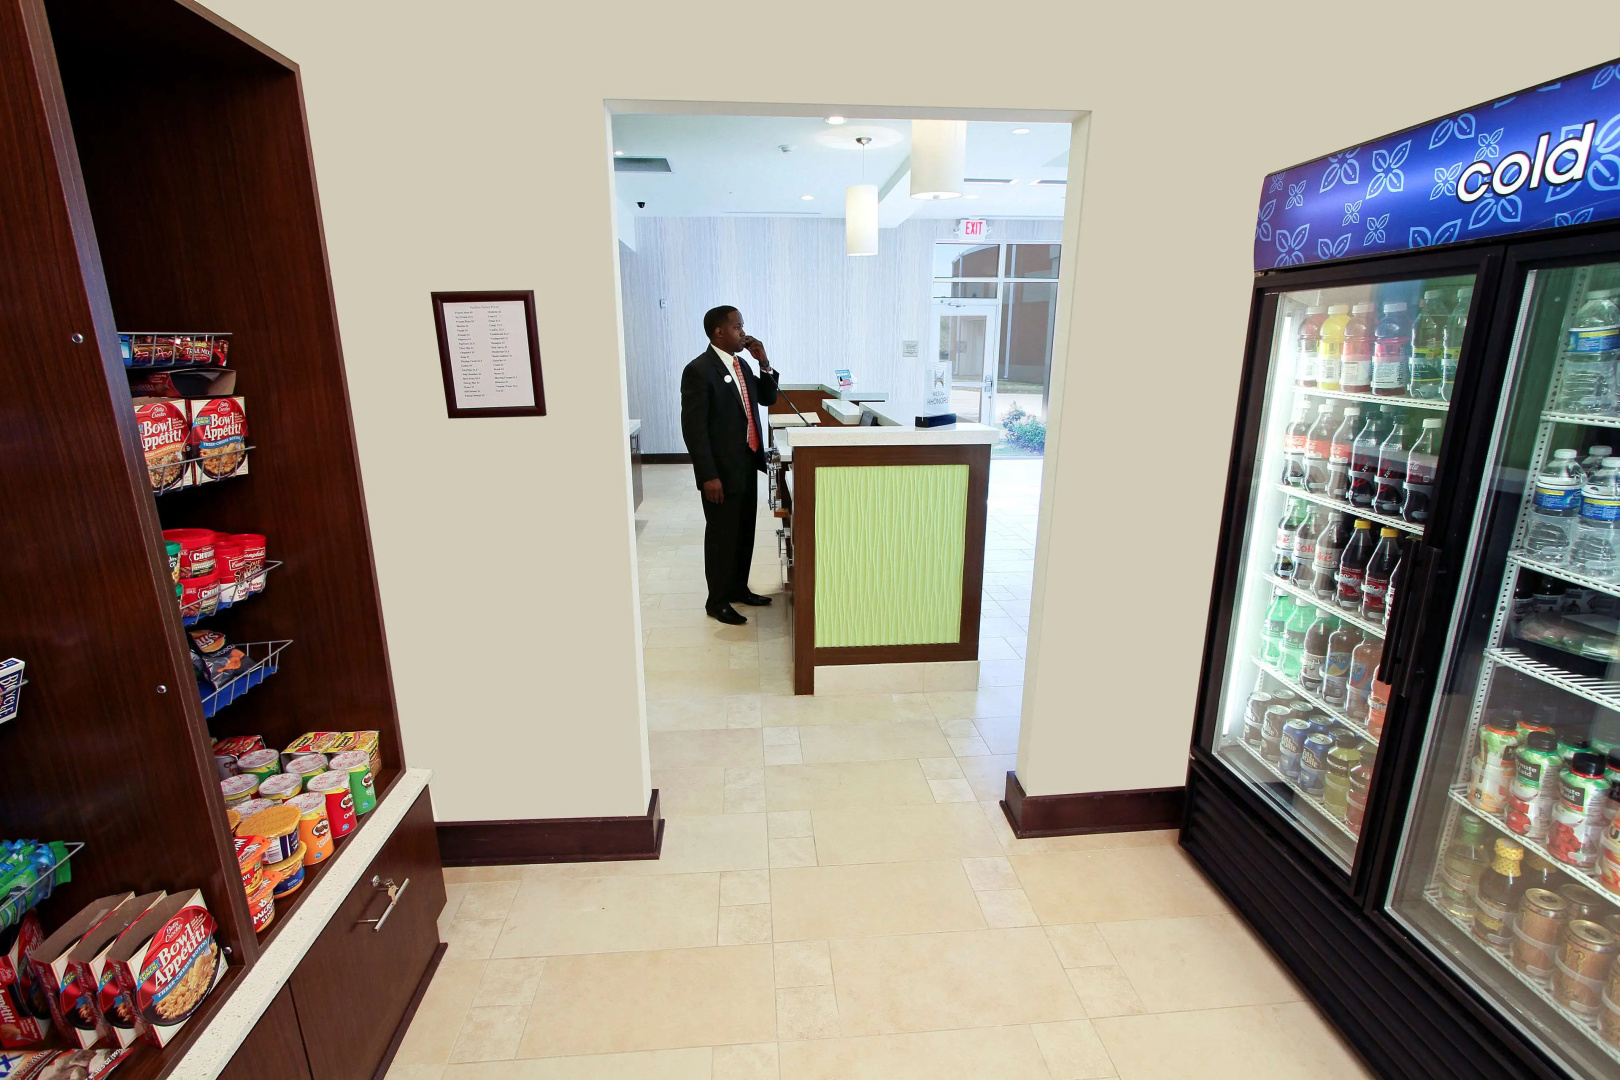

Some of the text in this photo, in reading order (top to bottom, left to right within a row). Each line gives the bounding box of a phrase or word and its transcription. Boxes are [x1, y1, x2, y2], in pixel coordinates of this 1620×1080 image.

[1456, 119, 1598, 204] cold
[965, 221, 983, 235] EXIT
[142, 417, 173, 437] Bowl
[210, 412, 235, 428] Bowl
[203, 423, 241, 440] Appétit!
[157, 923, 194, 970] Bowl
[154, 924, 206, 992] Appétit!
